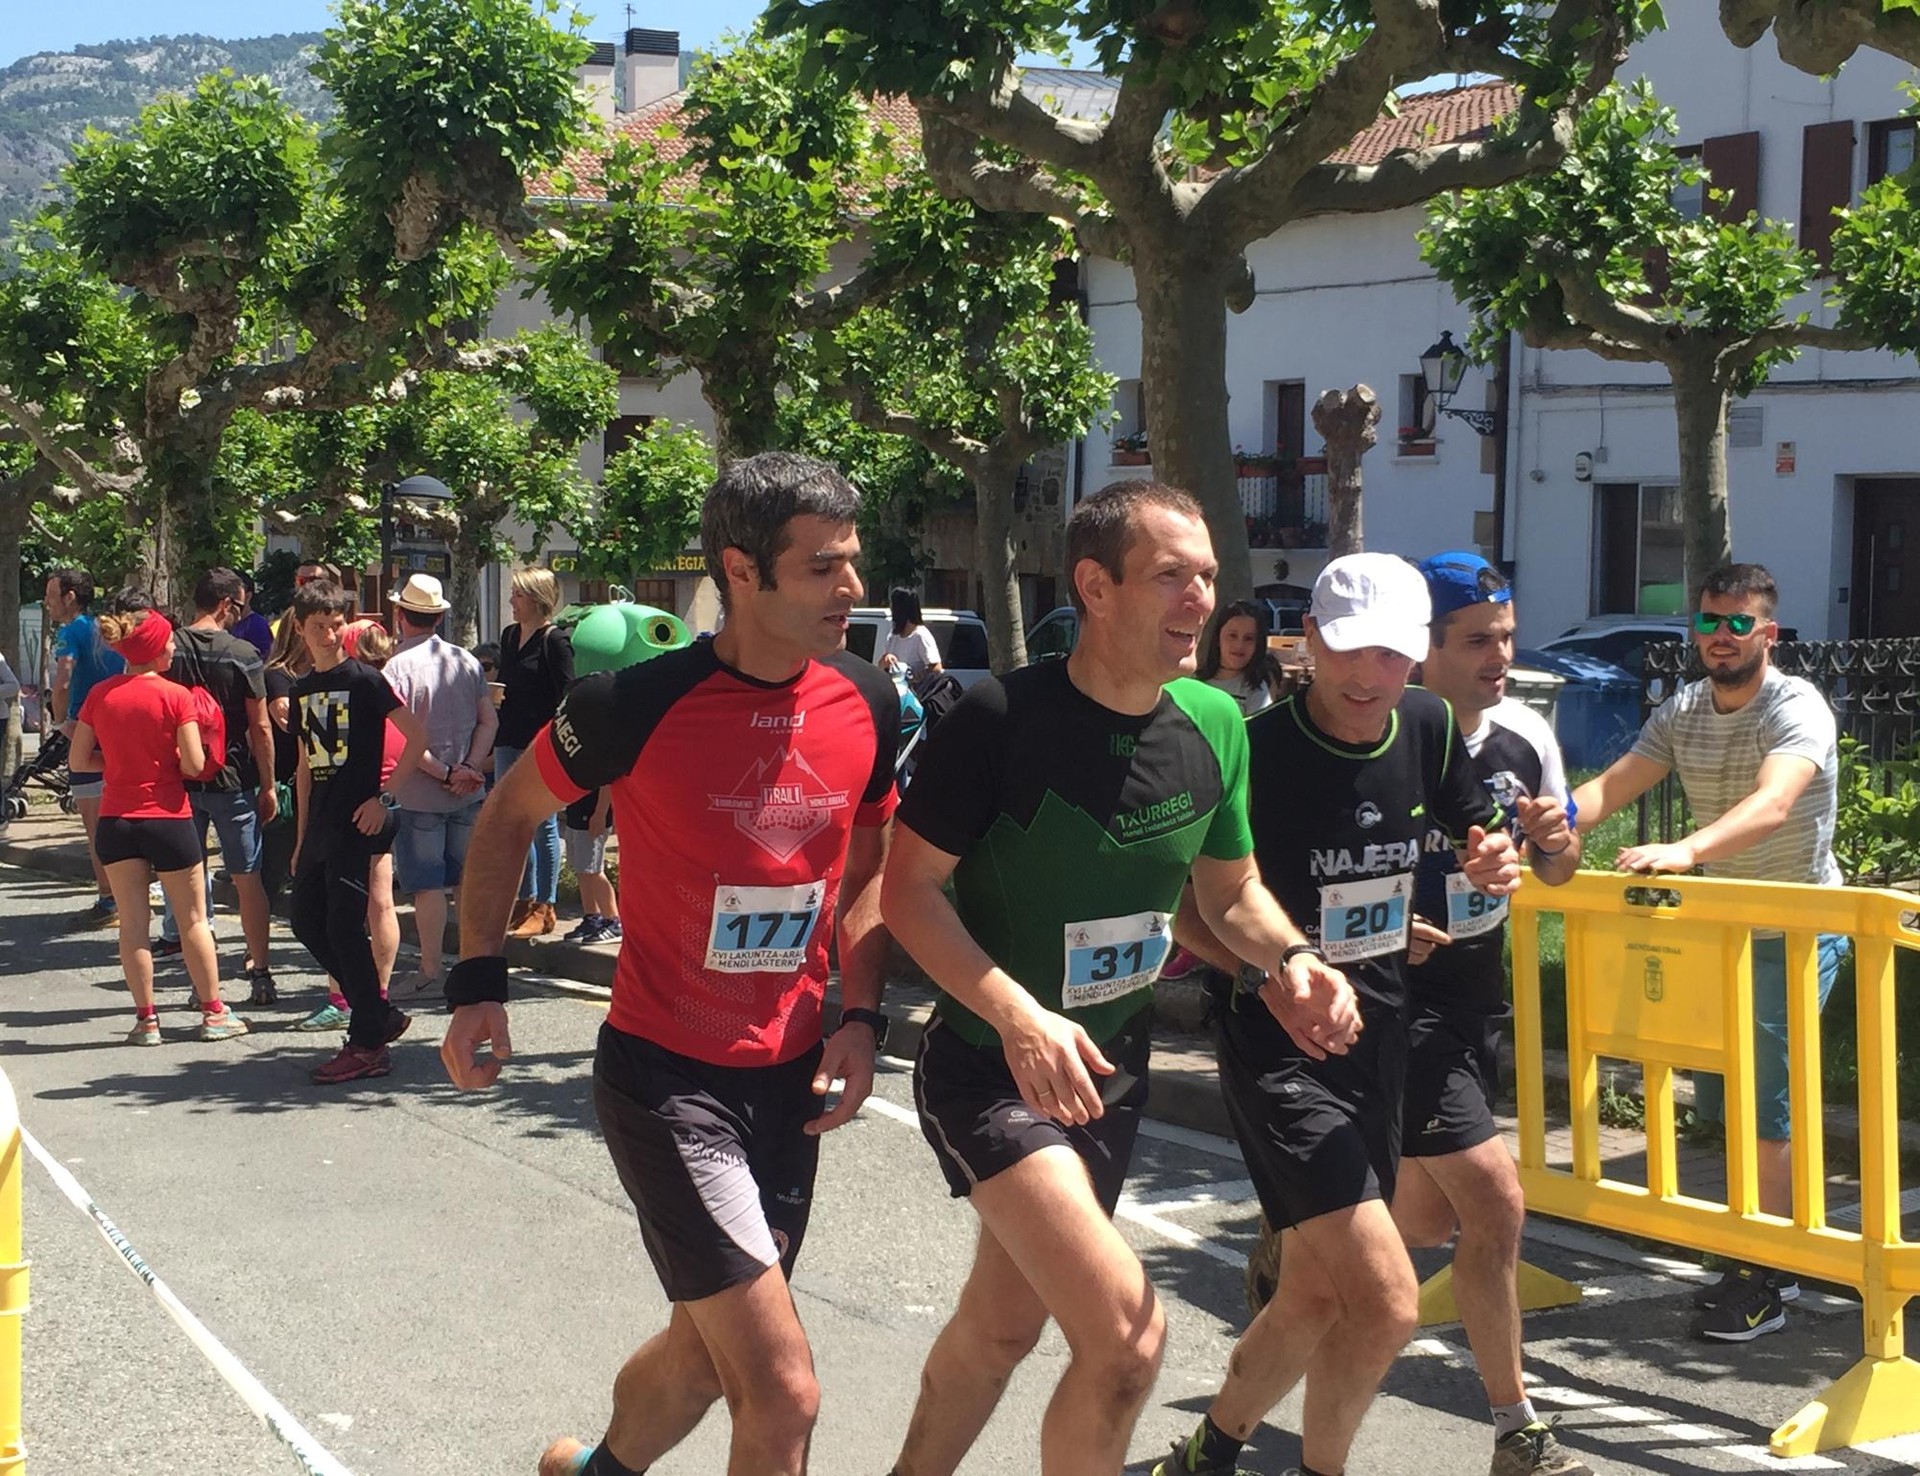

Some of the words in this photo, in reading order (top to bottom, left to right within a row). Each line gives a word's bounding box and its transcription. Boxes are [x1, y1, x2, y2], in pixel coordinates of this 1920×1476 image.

[1310, 838, 1420, 876] NAJERA
[726, 911, 813, 950] 177
[1344, 901, 1390, 939] 20
[711, 951, 727, 960] XVI
[718, 959, 749, 968] MENDI
[1091, 941, 1143, 981] 31
